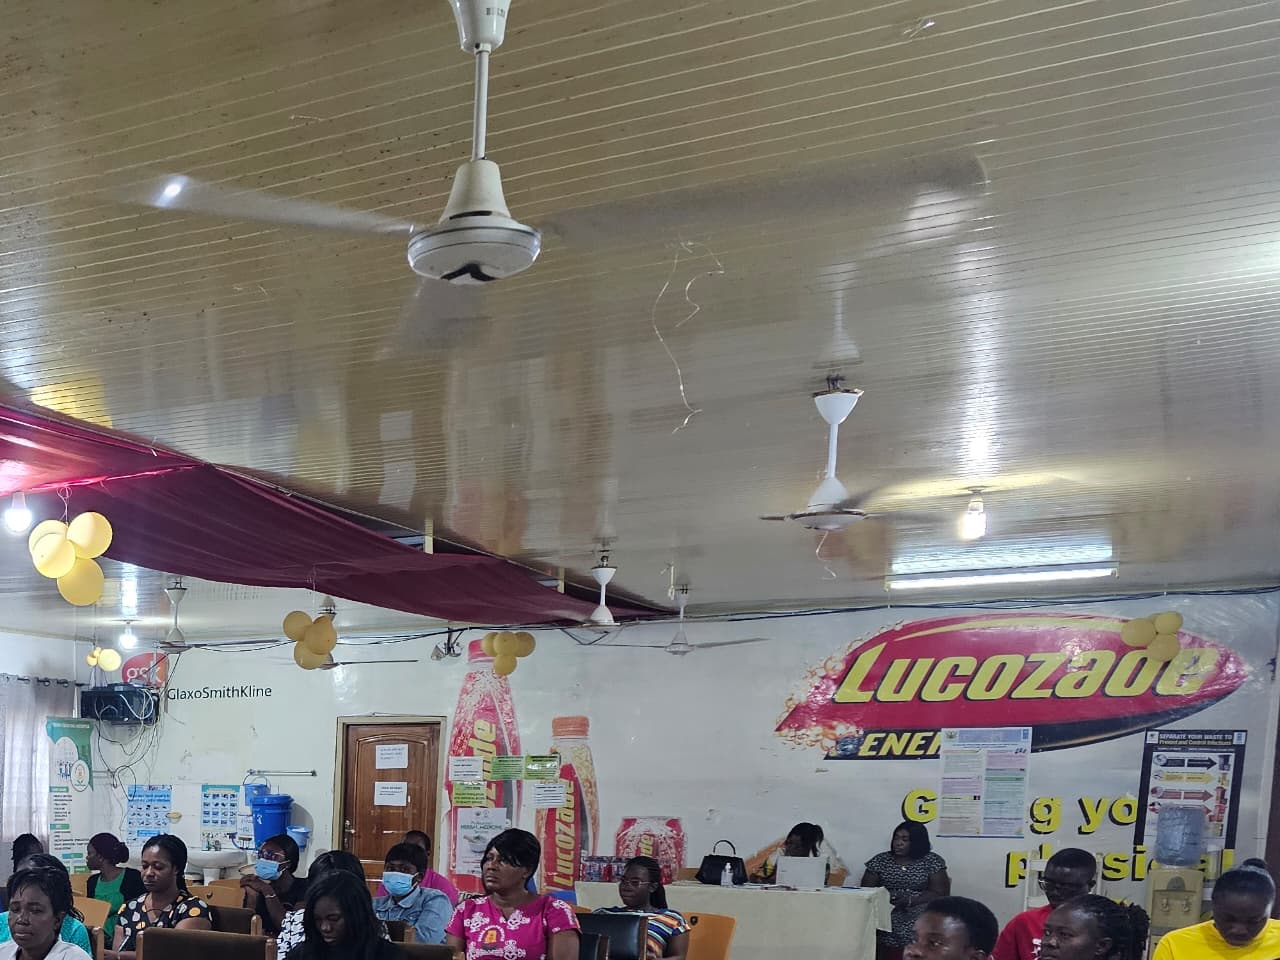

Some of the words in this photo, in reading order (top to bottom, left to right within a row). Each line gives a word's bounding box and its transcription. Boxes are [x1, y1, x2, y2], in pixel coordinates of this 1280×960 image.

[833, 641, 1220, 703] Lucozade
[167, 685, 272, 700] GlaxoSmithKline
[1078, 795, 1139, 835] yo
